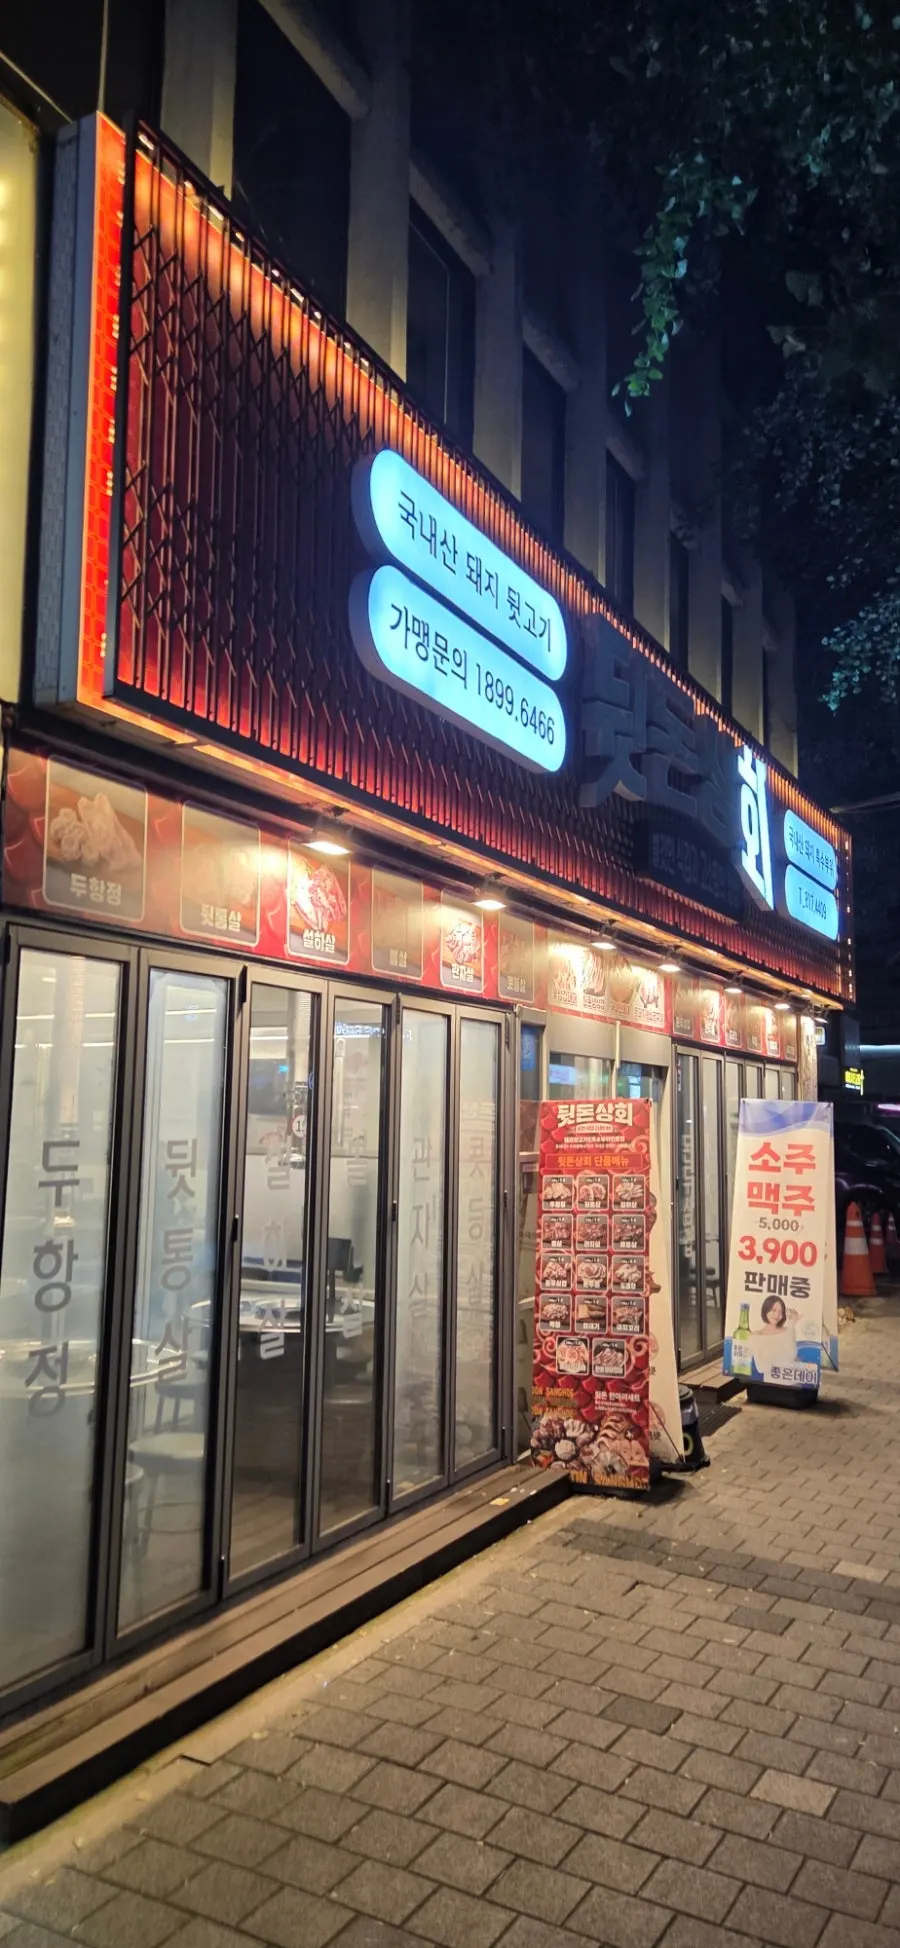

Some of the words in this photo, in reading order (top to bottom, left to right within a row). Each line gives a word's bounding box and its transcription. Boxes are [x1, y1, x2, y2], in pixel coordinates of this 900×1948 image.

[398, 490, 457, 574] 국내산
[466, 549, 500, 609] 돼지
[507, 588, 552, 652] 뒷고기
[390, 603, 467, 689] 가맹문의
[476, 663, 555, 745] 1899.6466
[789, 826, 804, 855] 국내산
[805, 839, 815, 864] 돼지
[70, 873, 122, 906] 두항정
[201, 903, 242, 932] 뒷통살
[303, 929, 336, 954] 설하살
[451, 963, 475, 983] 관자살
[557, 1102, 634, 1127] 뒷돈상회
[557, 1156, 592, 1167] 뒷돈상회
[594, 1155, 630, 1167] 단품메뉴
[748, 1141, 816, 1175] 소주
[747, 1181, 816, 1217] 맥주
[758, 1217, 799, 1232] 5,000
[155, 1138, 198, 1386] 뒷통살
[738, 1236, 817, 1267] 3,900
[25, 1139, 81, 1418] 두항정
[744, 1271, 811, 1299] 판매중
[771, 1366, 817, 1385] 좋은데이
